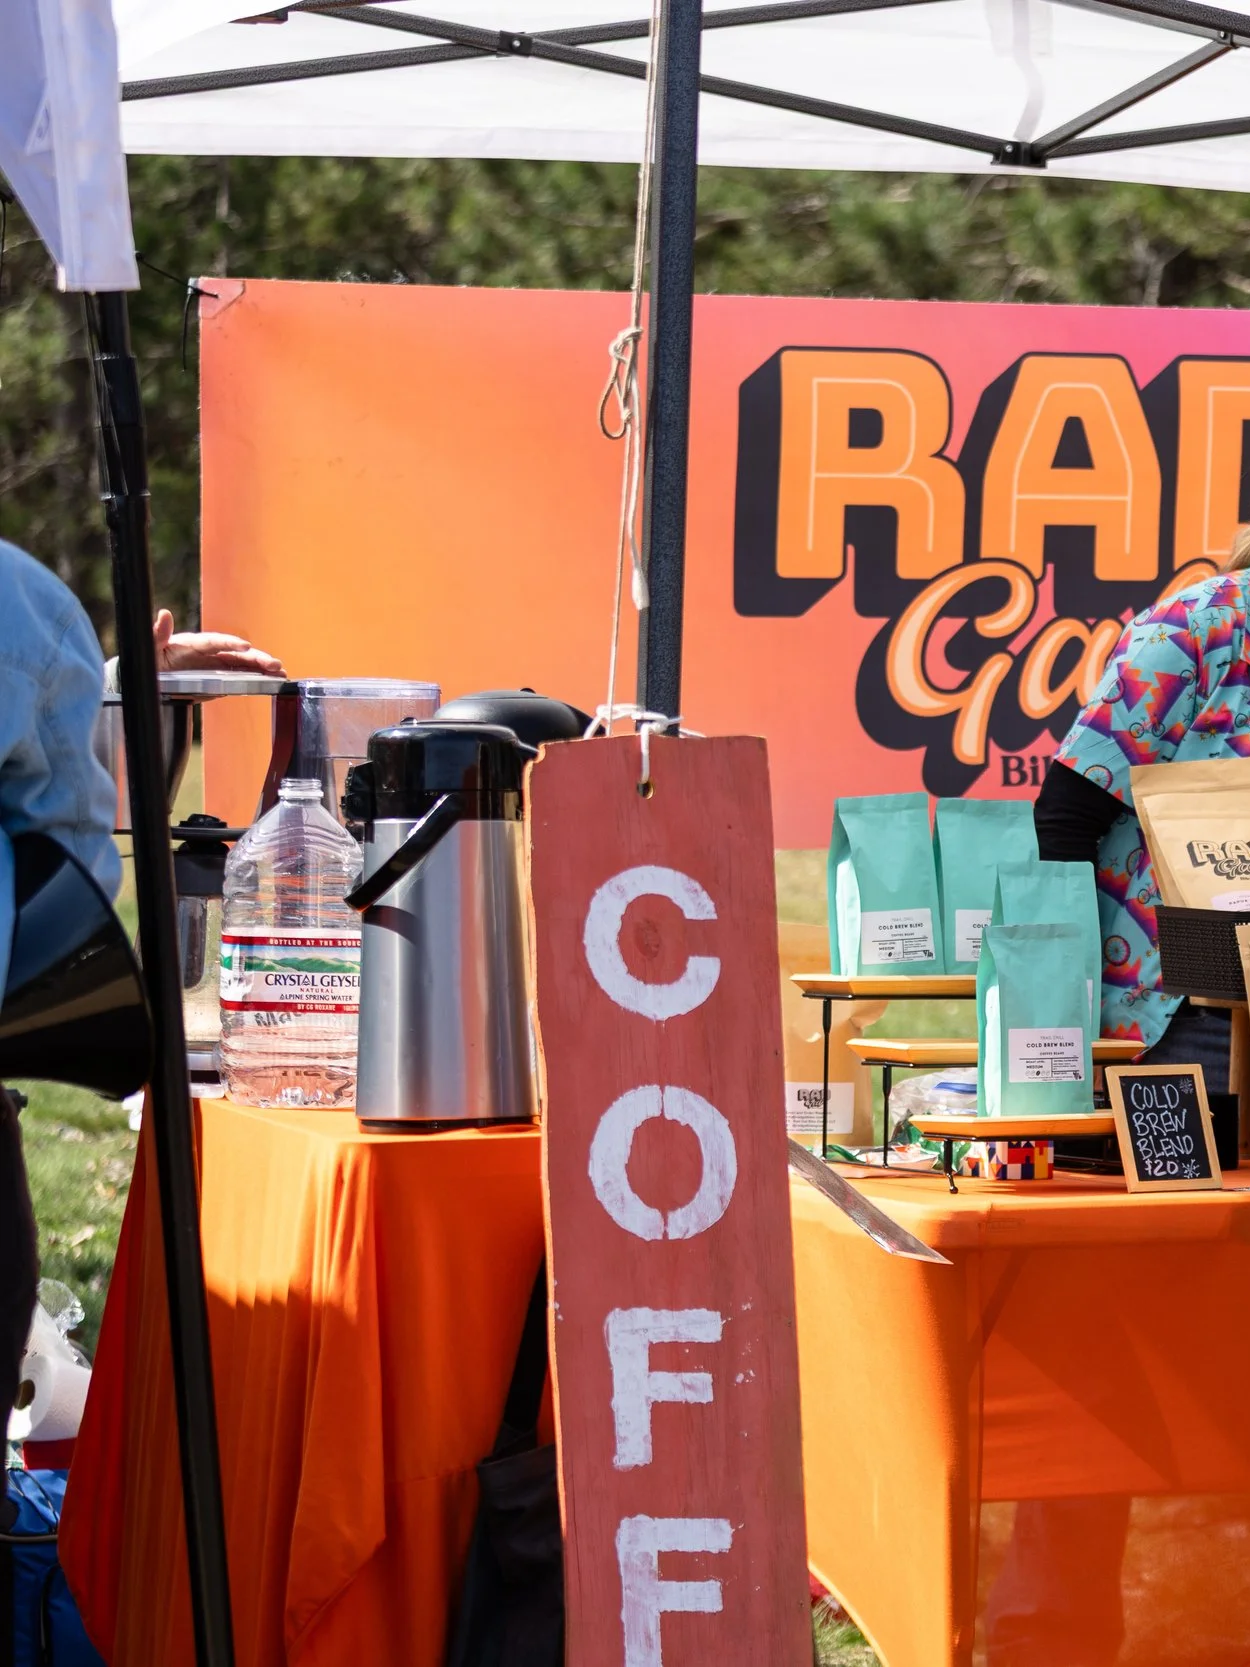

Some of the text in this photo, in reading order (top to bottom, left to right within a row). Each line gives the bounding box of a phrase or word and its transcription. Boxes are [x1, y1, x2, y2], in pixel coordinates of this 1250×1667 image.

[269, 938, 302, 946] BOTTLED
[265, 973, 360, 988] CRYSTAL GEYSE
[1131, 1082, 1180, 1110] COLD
[1131, 1108, 1188, 1136] BREW
[1135, 1135, 1194, 1161] BLEND
[1144, 1159, 1179, 1177] $20
